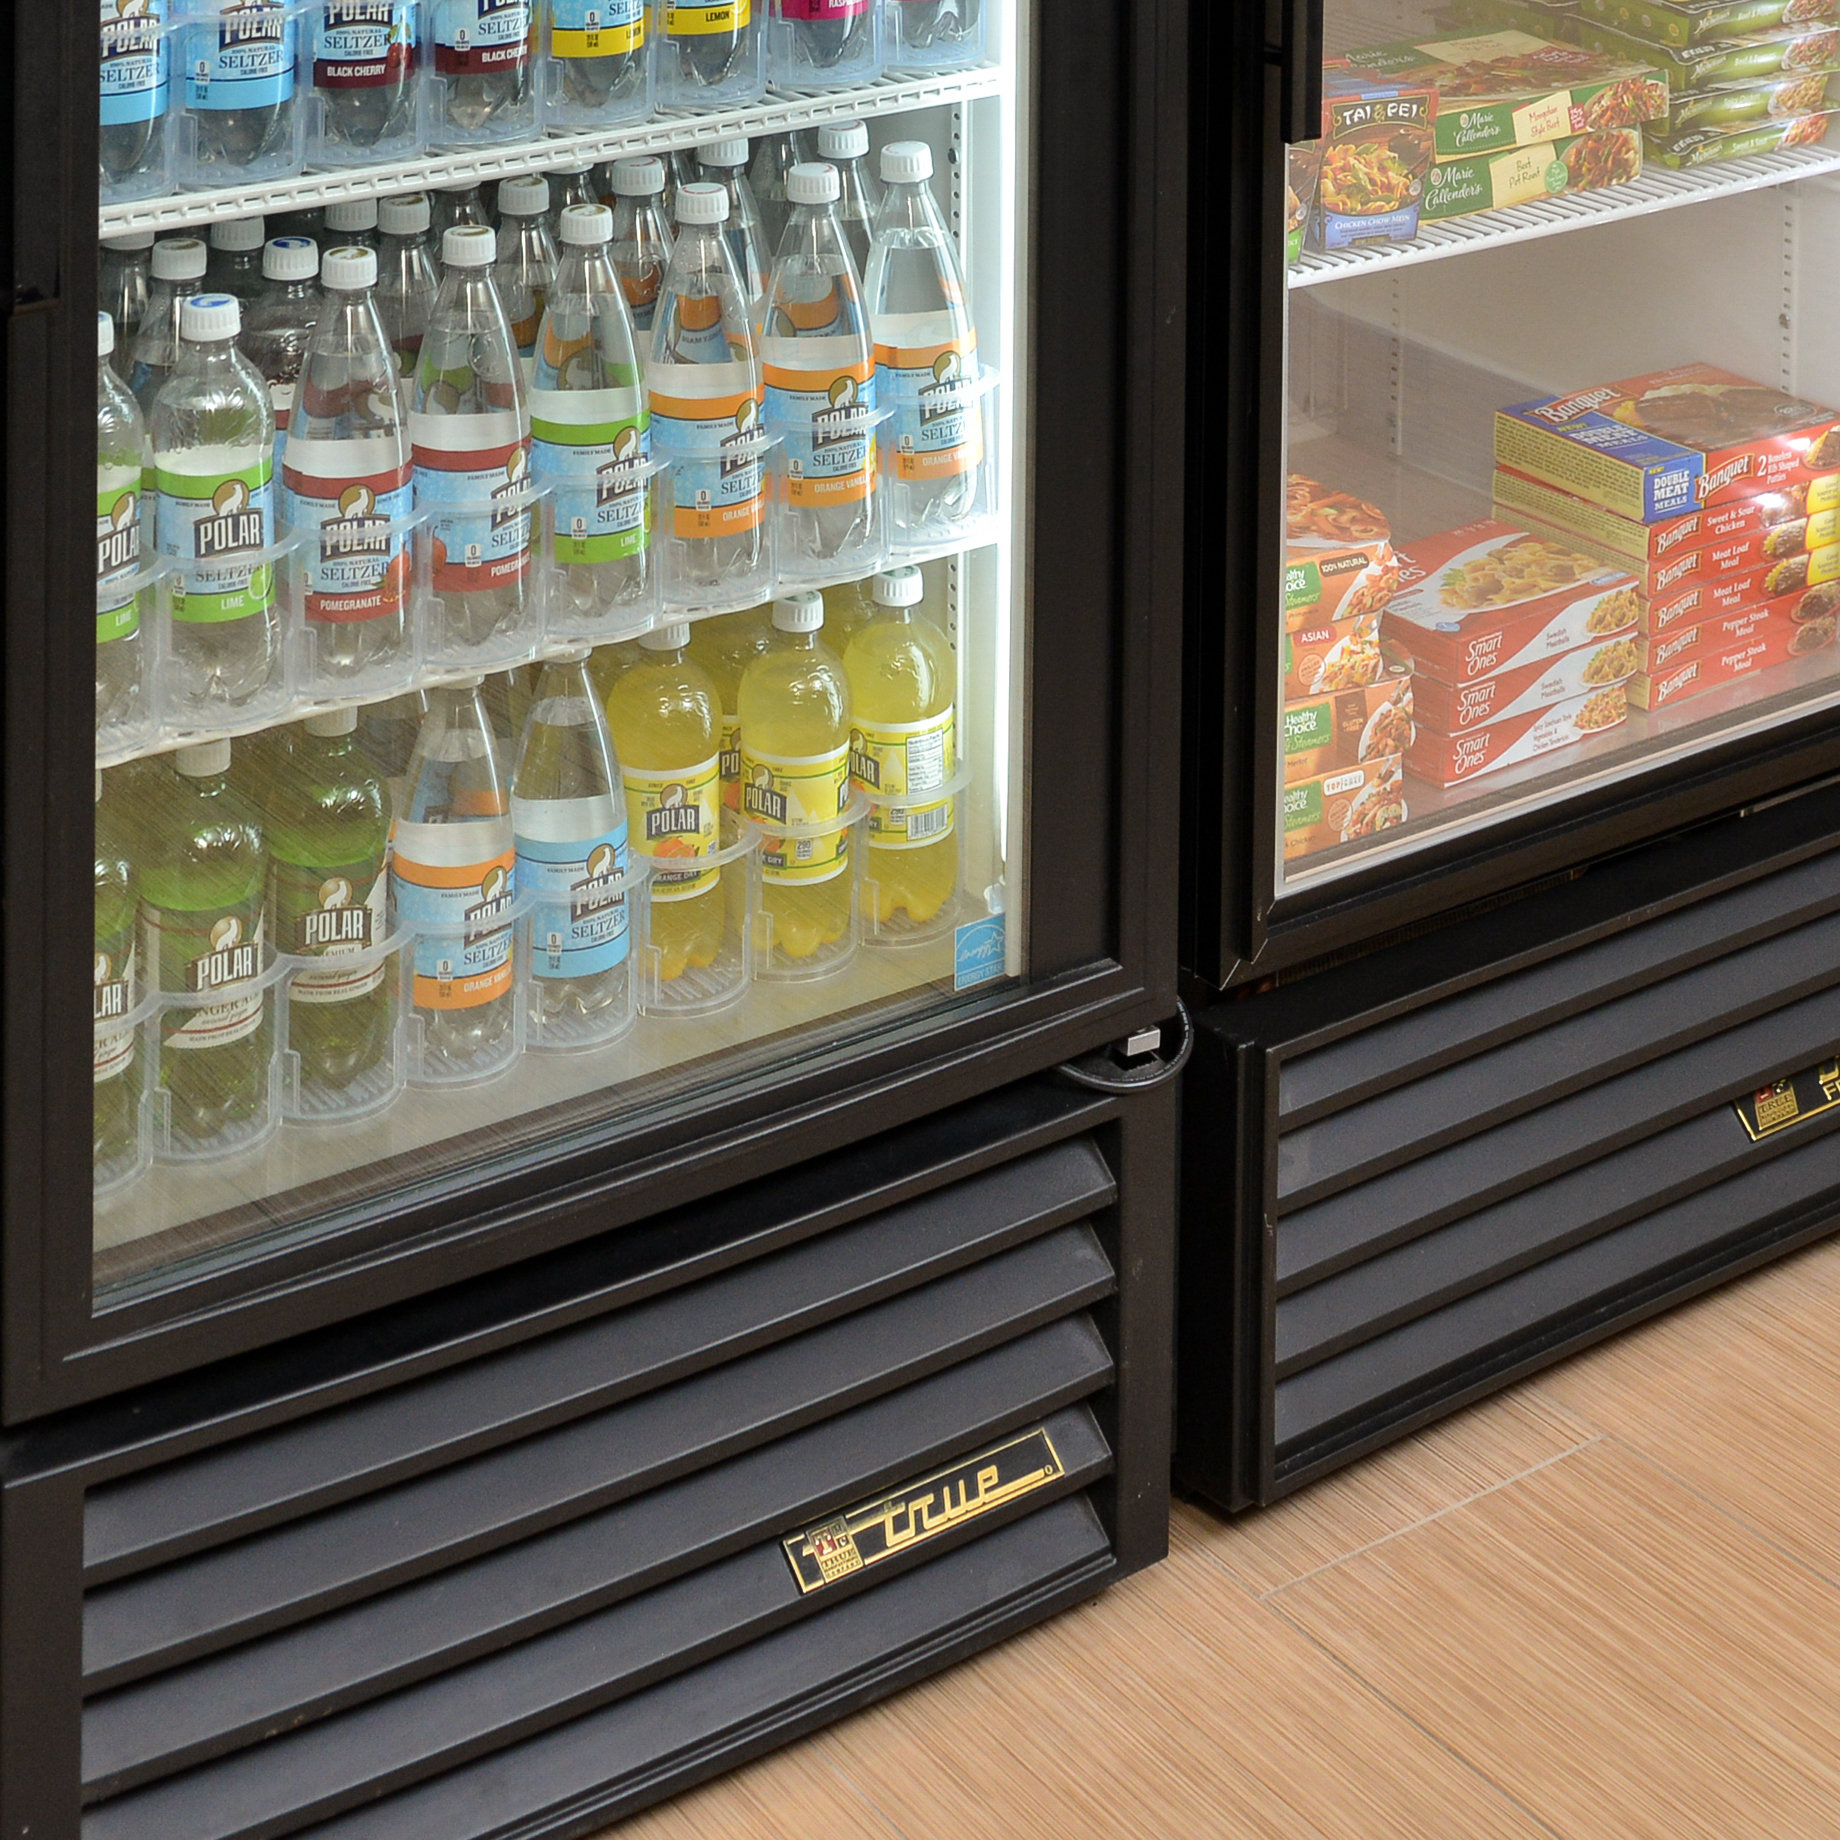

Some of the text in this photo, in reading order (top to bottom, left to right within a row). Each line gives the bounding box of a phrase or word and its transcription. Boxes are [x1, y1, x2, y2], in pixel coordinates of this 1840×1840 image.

[704, 9, 731, 23] LEMON
[323, 33, 392, 50] SELTZER
[218, 49, 285, 70] SELTZER
[481, 49, 505, 63] BLACK
[326, 62, 386, 77] BLACK CHERRY
[1343, 102, 1418, 126] TAI PEI
[1468, 112, 1495, 130] Marie
[1453, 124, 1502, 148] Callender's
[1440, 166, 1475, 188] Marie
[1424, 184, 1484, 211] Callender's
[1334, 219, 1367, 230] CHICKEN
[1367, 216, 1391, 227] CHOW
[1535, 386, 1621, 424] Banquet
[921, 453, 949, 467] ORANGE
[1757, 455, 1767, 477] 2
[814, 479, 846, 494] ORANGE
[1653, 470, 1690, 491] DOUBLE
[1698, 455, 1750, 501] Banquet
[1653, 483, 1689, 503] MEAT
[1654, 497, 1688, 511] MEALS
[722, 508, 749, 522] ORANGE
[1707, 512, 1730, 527] Sweet
[1737, 505, 1755, 519] Sour
[198, 520, 261, 554] POLAR
[1656, 517, 1698, 554] Banquet
[1715, 519, 1746, 535] Chicken
[620, 534, 637, 548] LIME
[1712, 541, 1750, 561] Meat Loaf
[320, 563, 390, 581] SELTZER
[1336, 555, 1368, 570] NATURAL
[1656, 553, 1698, 591] Banquet
[1720, 556, 1740, 570] Meal
[1713, 578, 1752, 599] Meat Loaf
[220, 596, 245, 610] LIME
[320, 596, 382, 612] POMEGRANATE
[1657, 590, 1699, 628] Banquet
[1721, 594, 1741, 607] Meal
[1722, 609, 1770, 632] Pepper Steak
[1300, 629, 1331, 643] ASIAN
[1735, 625, 1755, 638] Meal
[1465, 634, 1503, 662] Smart
[1655, 628, 1698, 665] Banquet
[1721, 642, 1767, 667] Pepper Steak
[1467, 653, 1498, 676] Ones
[1733, 658, 1753, 672] Meal
[1657, 663, 1698, 702] Banquet
[1457, 684, 1496, 711] Smart
[1459, 703, 1491, 726] Ones
[1452, 733, 1491, 761] Smart
[1454, 751, 1486, 775] Ones
[745, 791, 783, 820] POLAR
[650, 811, 696, 834] POLAR
[304, 913, 364, 945] POLAR
[570, 912, 626, 941] SELTZER
[197, 956, 253, 991] POLAR
[463, 975, 492, 994] ORANGE
